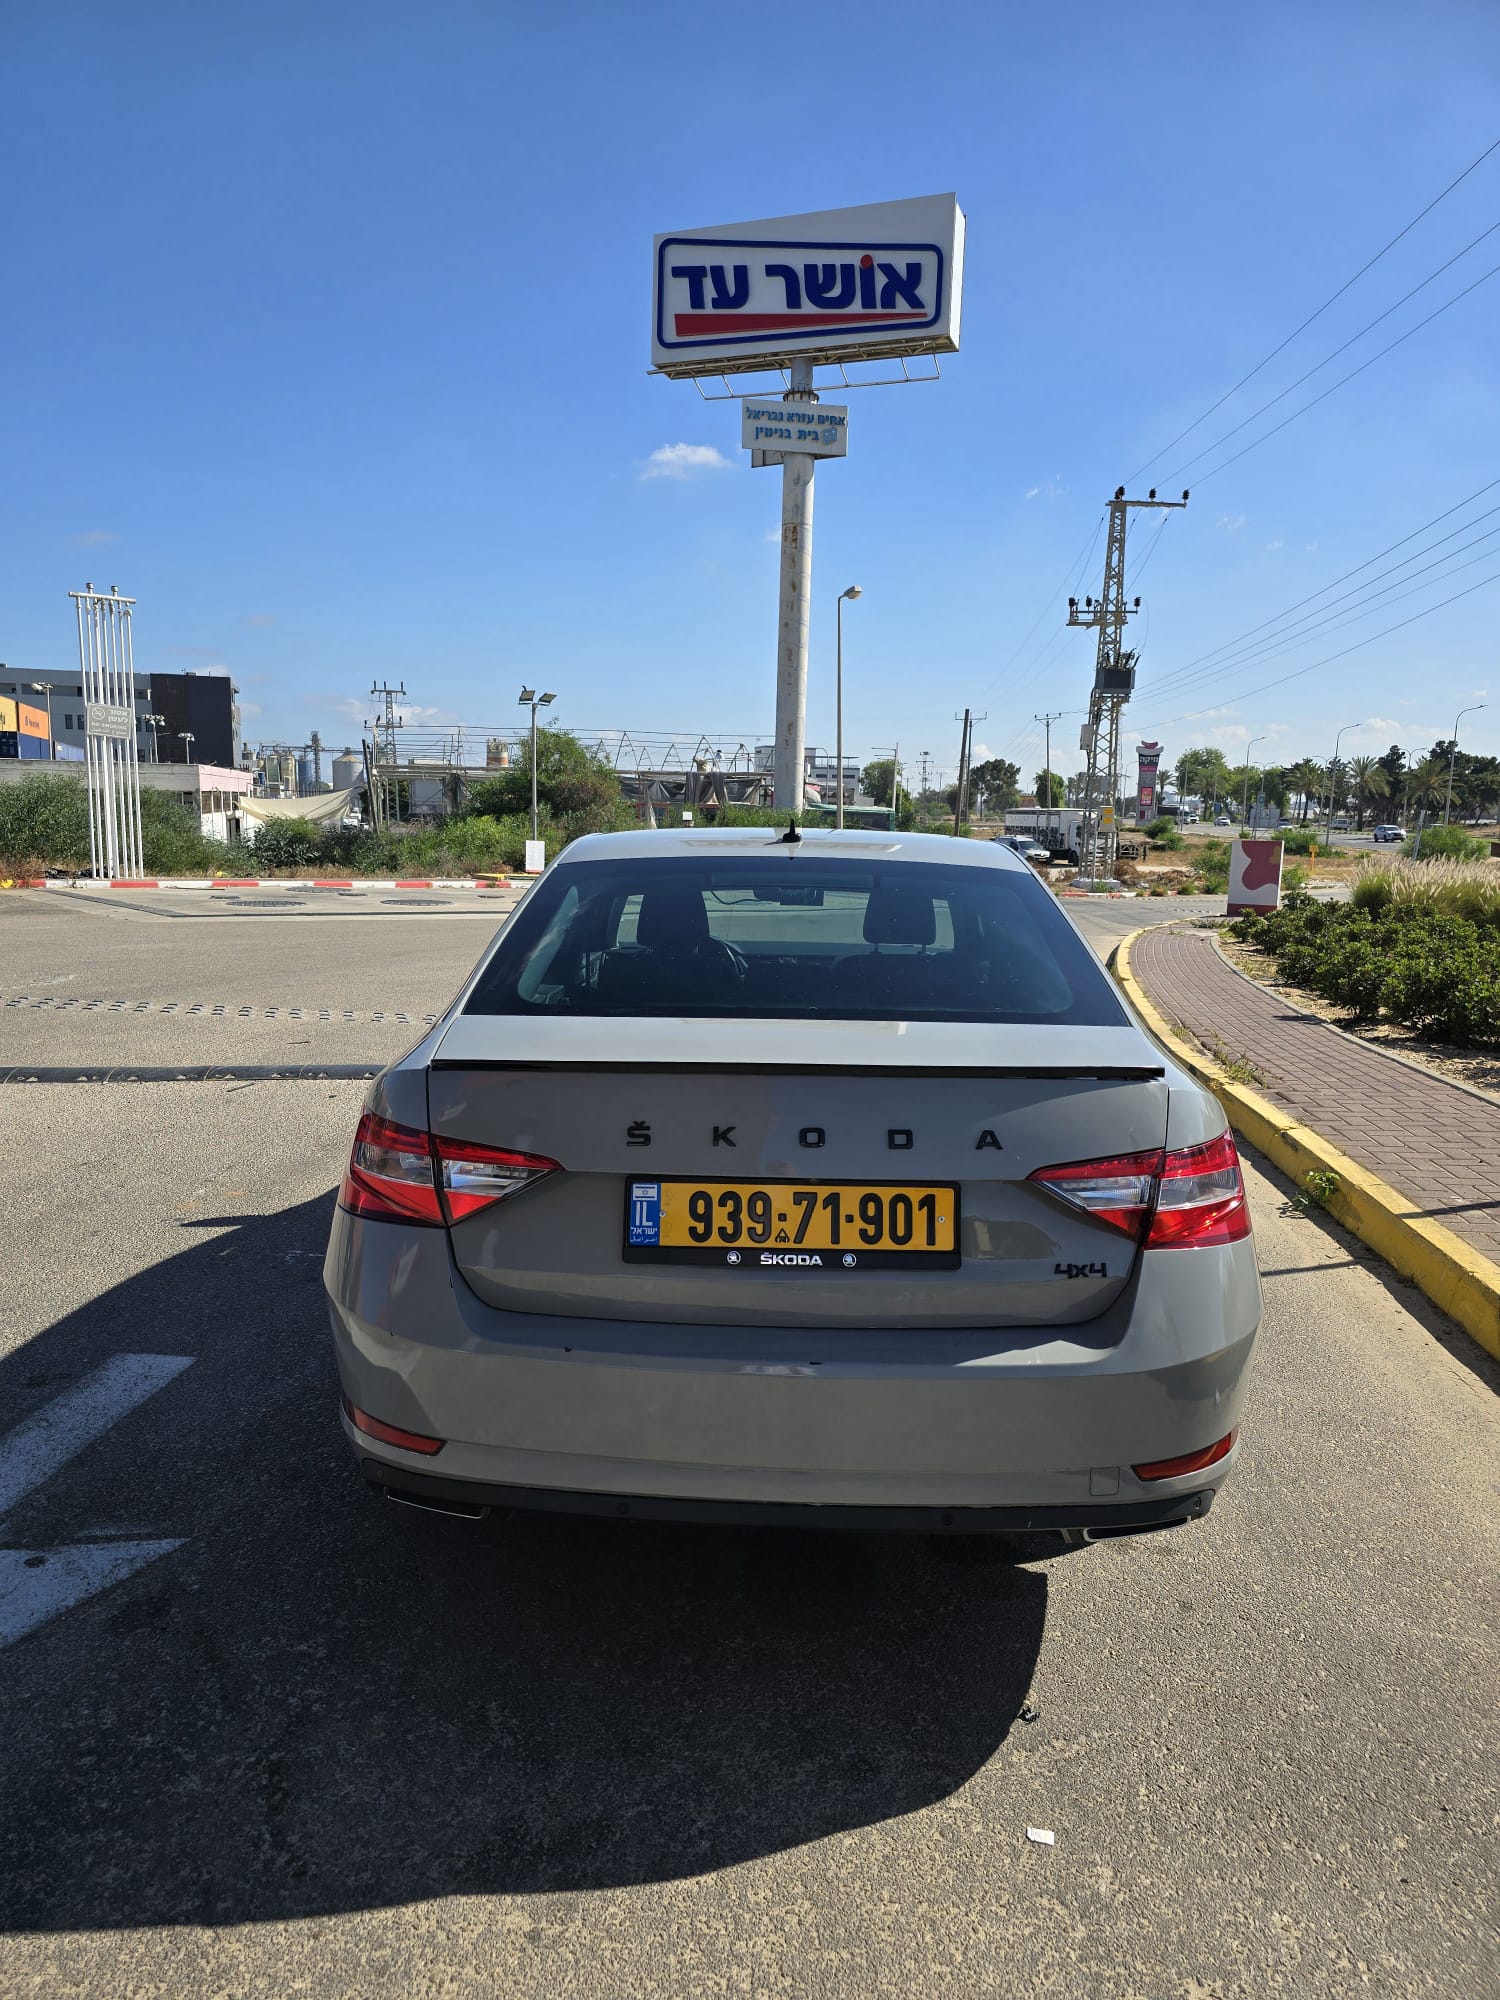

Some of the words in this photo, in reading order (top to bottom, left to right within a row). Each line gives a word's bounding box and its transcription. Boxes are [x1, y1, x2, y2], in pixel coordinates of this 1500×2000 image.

[671, 264, 750, 310] עד
[765, 254, 925, 310] אושר
[745, 406, 784, 422] גבריאל
[786, 410, 815, 424] עזרא
[817, 413, 846, 426] אחים
[755, 425, 792, 440] בנימין
[797, 429, 820, 441] בית
[625, 1121, 1003, 1151] ŠKODA
[635, 1201, 653, 1226] IL
[630, 1226, 658, 1235] ישראל
[760, 1252, 823, 1266] ŠKODA
